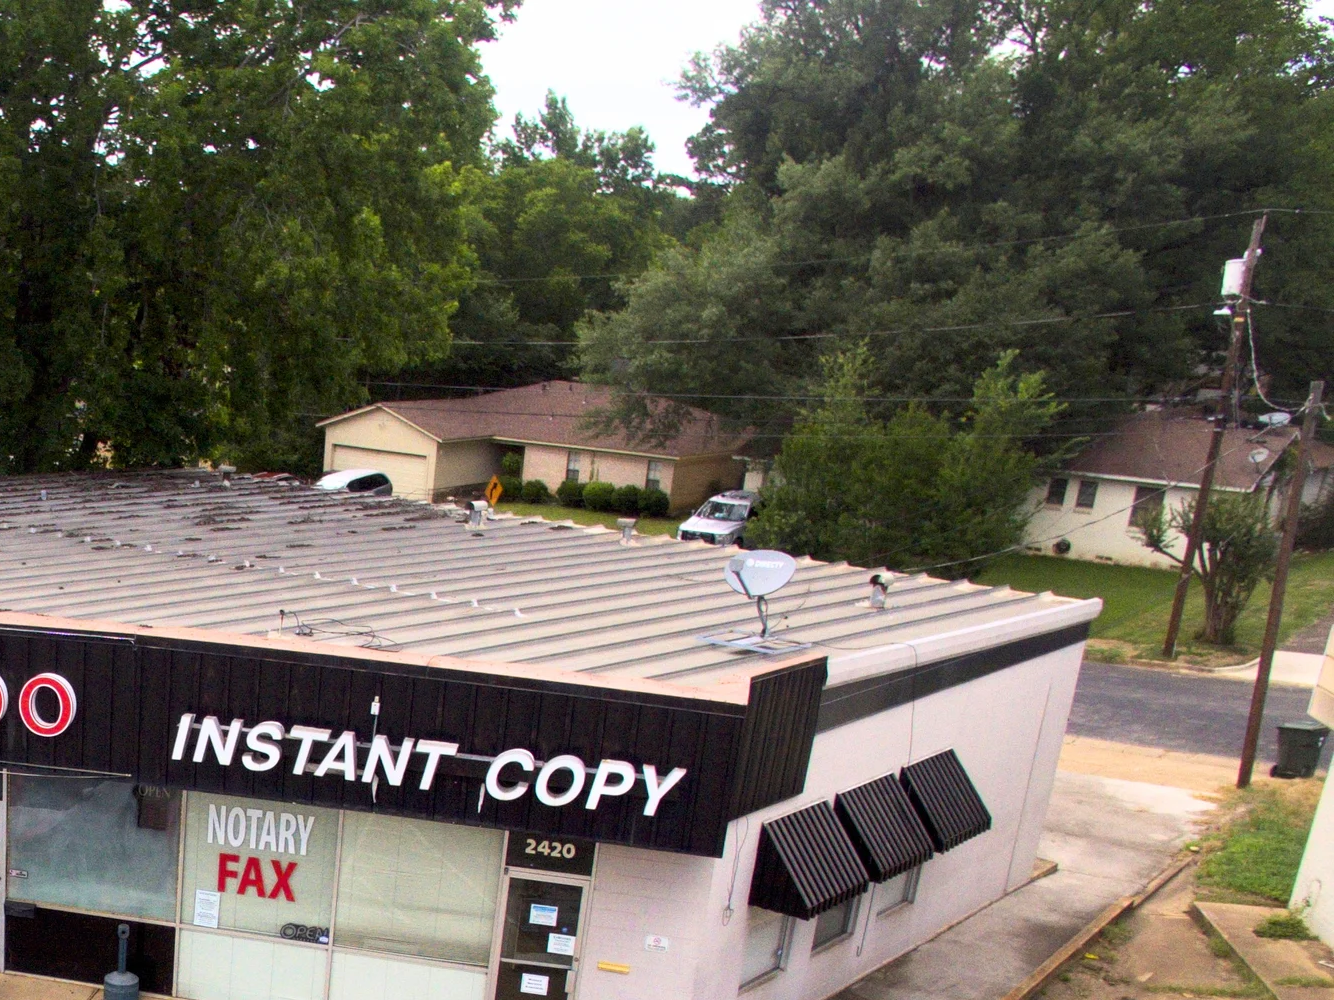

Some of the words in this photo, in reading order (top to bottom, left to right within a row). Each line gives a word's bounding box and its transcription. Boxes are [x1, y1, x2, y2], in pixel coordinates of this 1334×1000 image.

[171, 713, 458, 791] INSTANT
[485, 748, 686, 817] COPY
[207, 803, 315, 856] NOTARY
[525, 838, 576, 859] 2420
[217, 853, 298, 902] FAX
